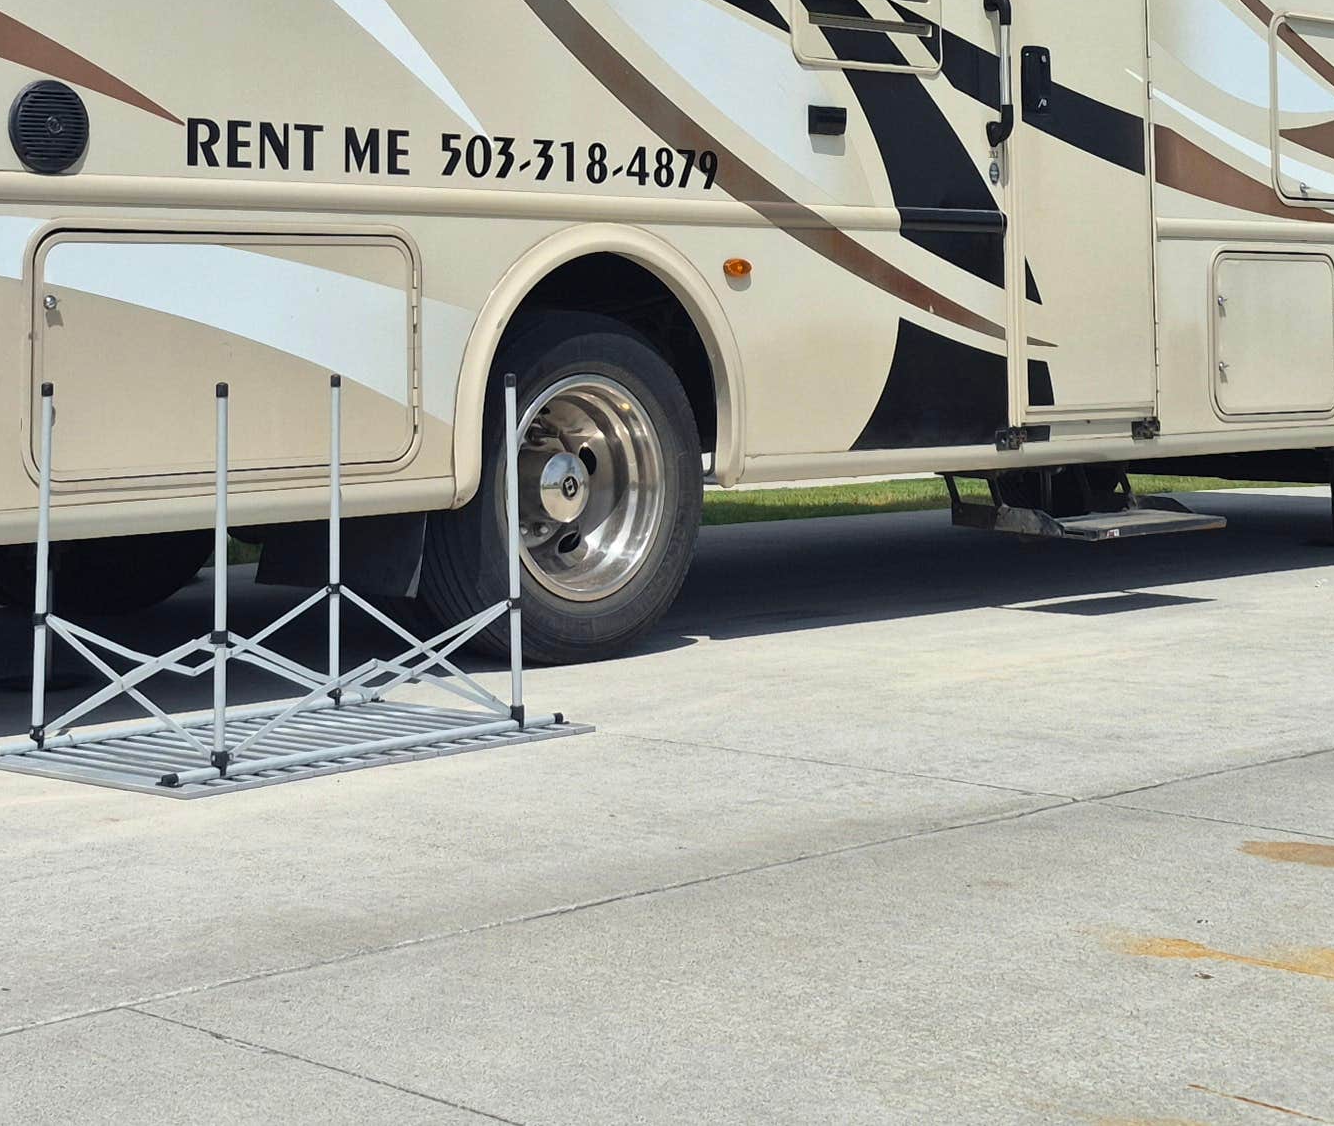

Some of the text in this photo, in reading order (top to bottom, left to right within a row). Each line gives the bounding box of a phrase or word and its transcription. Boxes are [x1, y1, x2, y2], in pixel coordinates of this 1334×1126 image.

[186, 117, 719, 190] RENT ME 503-318-4879
